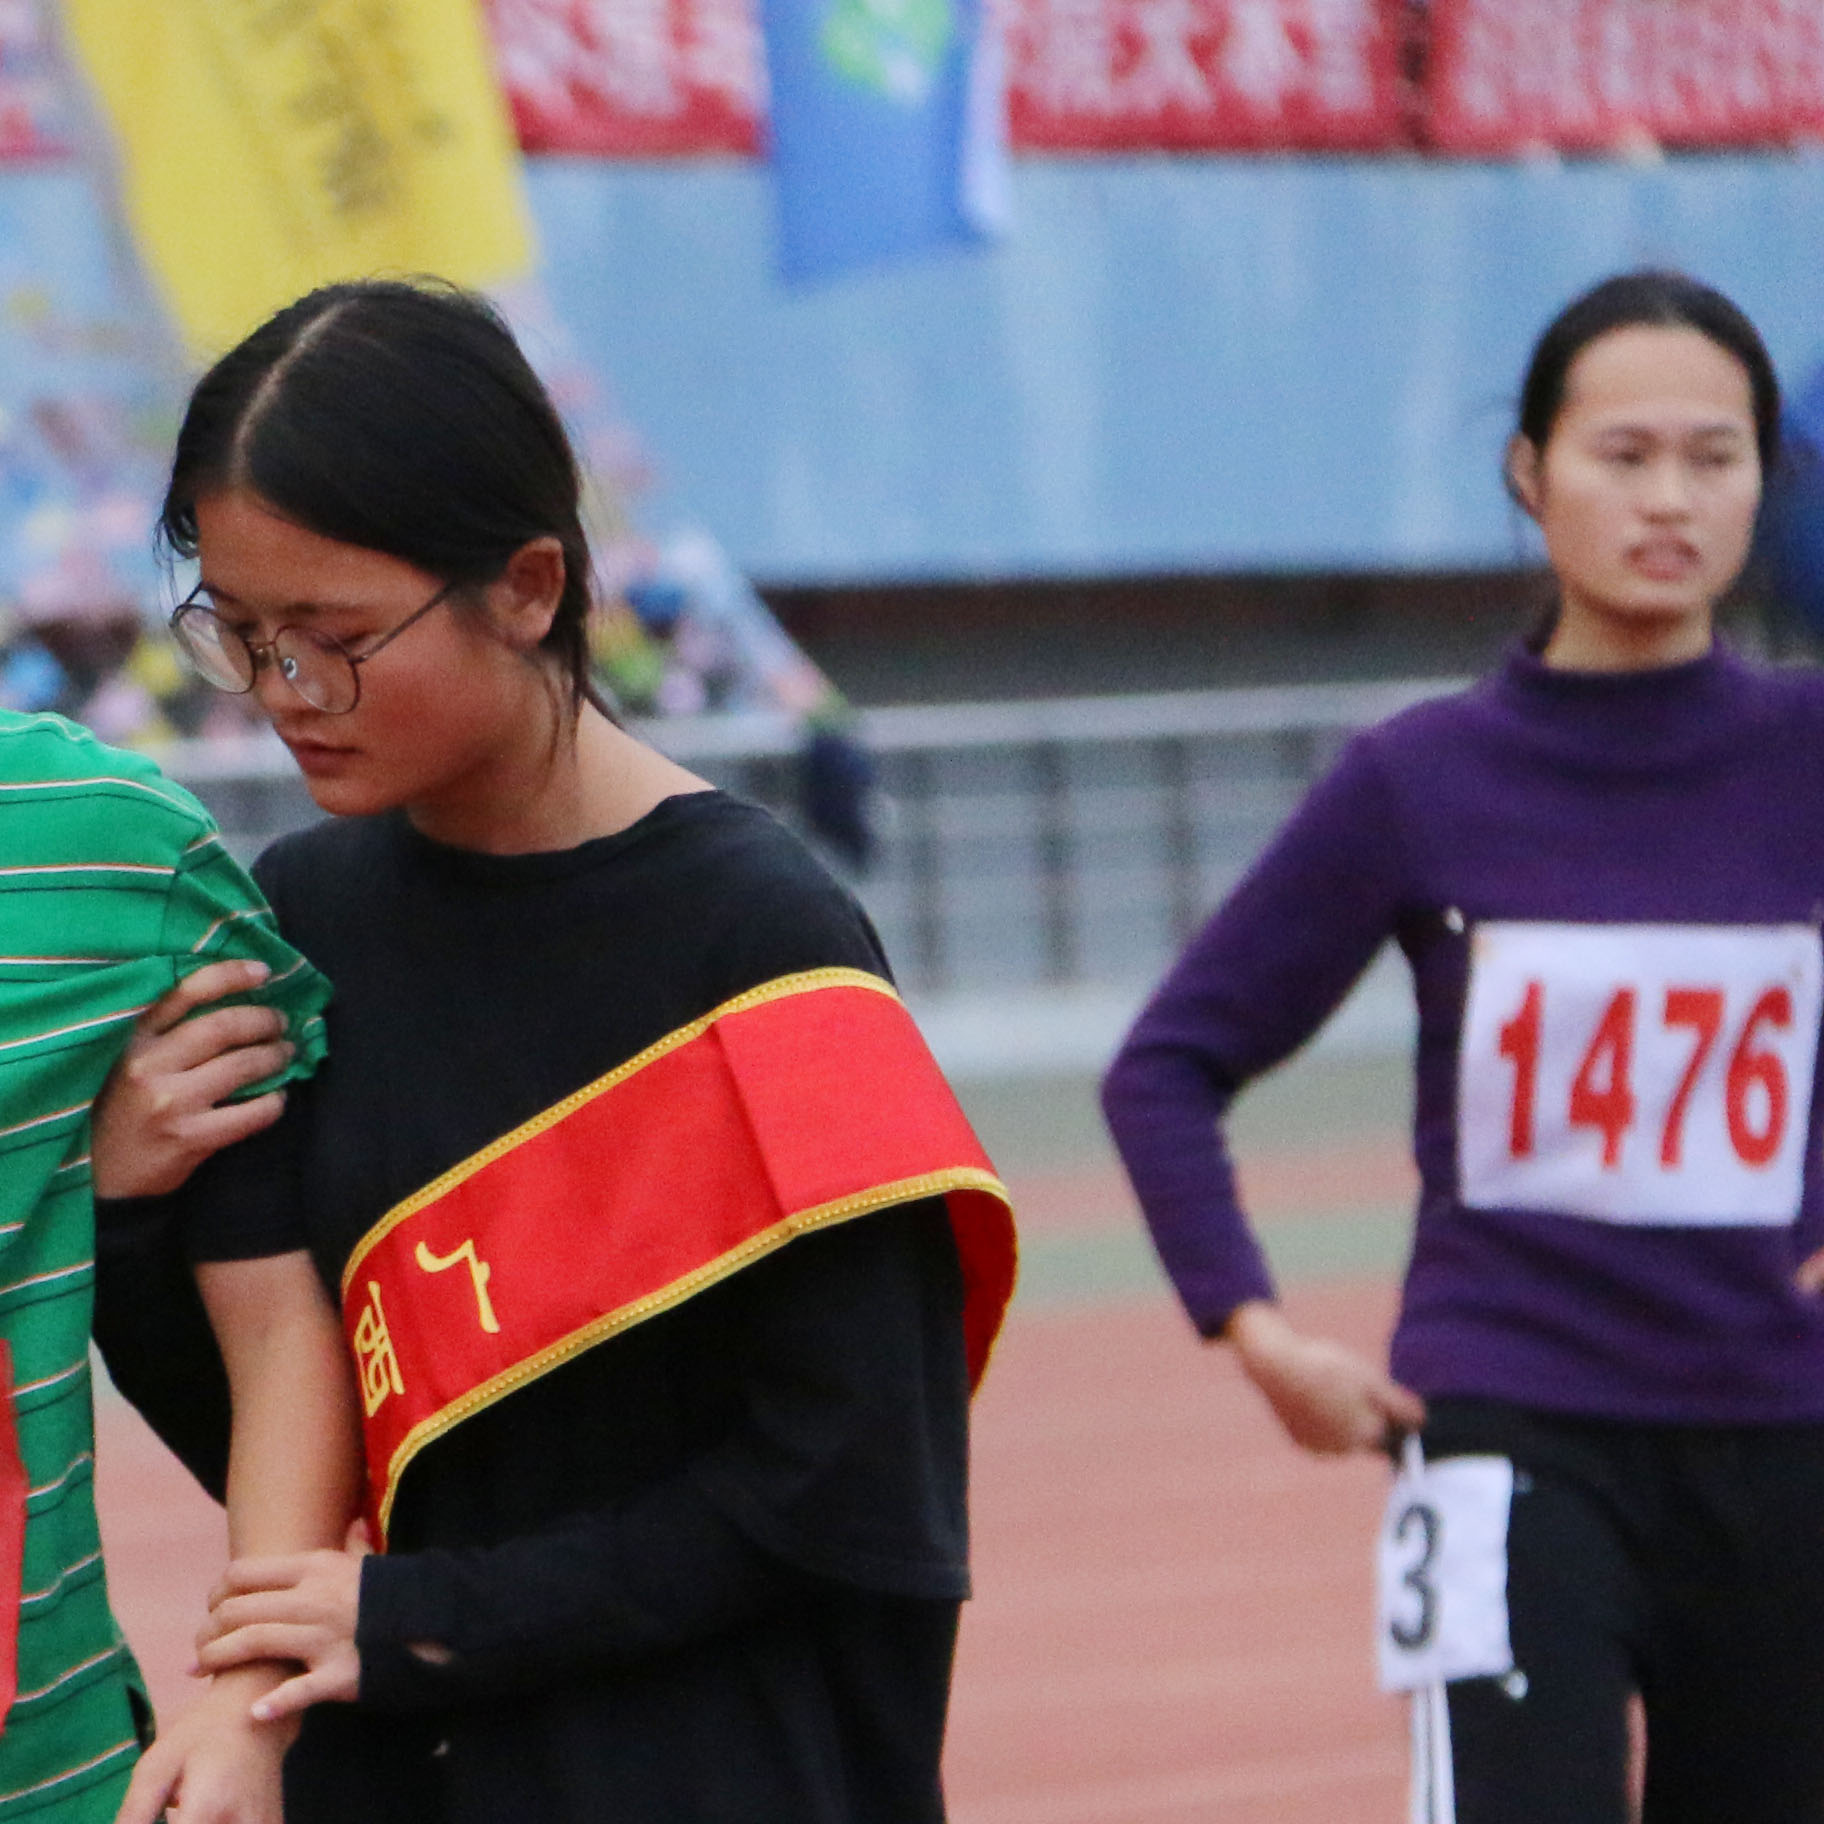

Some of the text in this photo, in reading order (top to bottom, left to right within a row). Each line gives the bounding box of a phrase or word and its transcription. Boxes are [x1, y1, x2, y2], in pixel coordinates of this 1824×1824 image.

[1496, 979, 1791, 1173] 1476
[352, 1238, 500, 1418] 广西
[1389, 1503, 1445, 1652] 3
